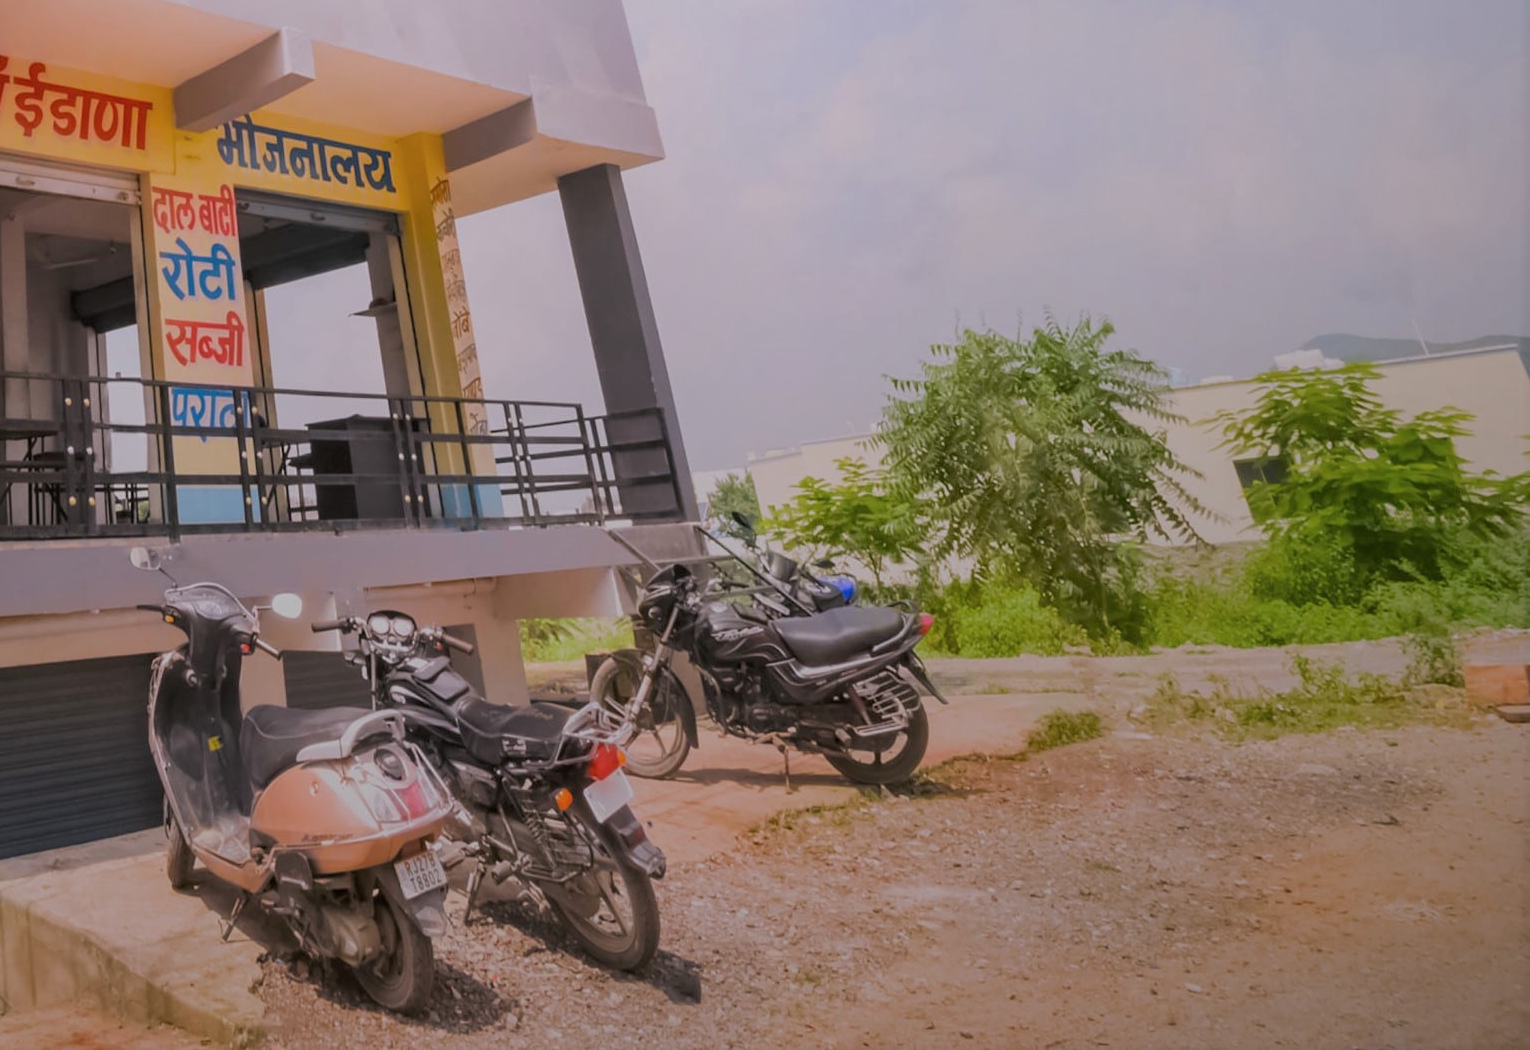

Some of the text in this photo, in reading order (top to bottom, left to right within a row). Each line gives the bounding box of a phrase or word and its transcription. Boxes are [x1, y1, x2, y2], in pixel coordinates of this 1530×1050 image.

[13, 61, 153, 150] ईडाणा
[152, 183, 236, 237] दाल बाटी
[159, 236, 237, 301] रोटी
[164, 310, 244, 367] सब्जी
